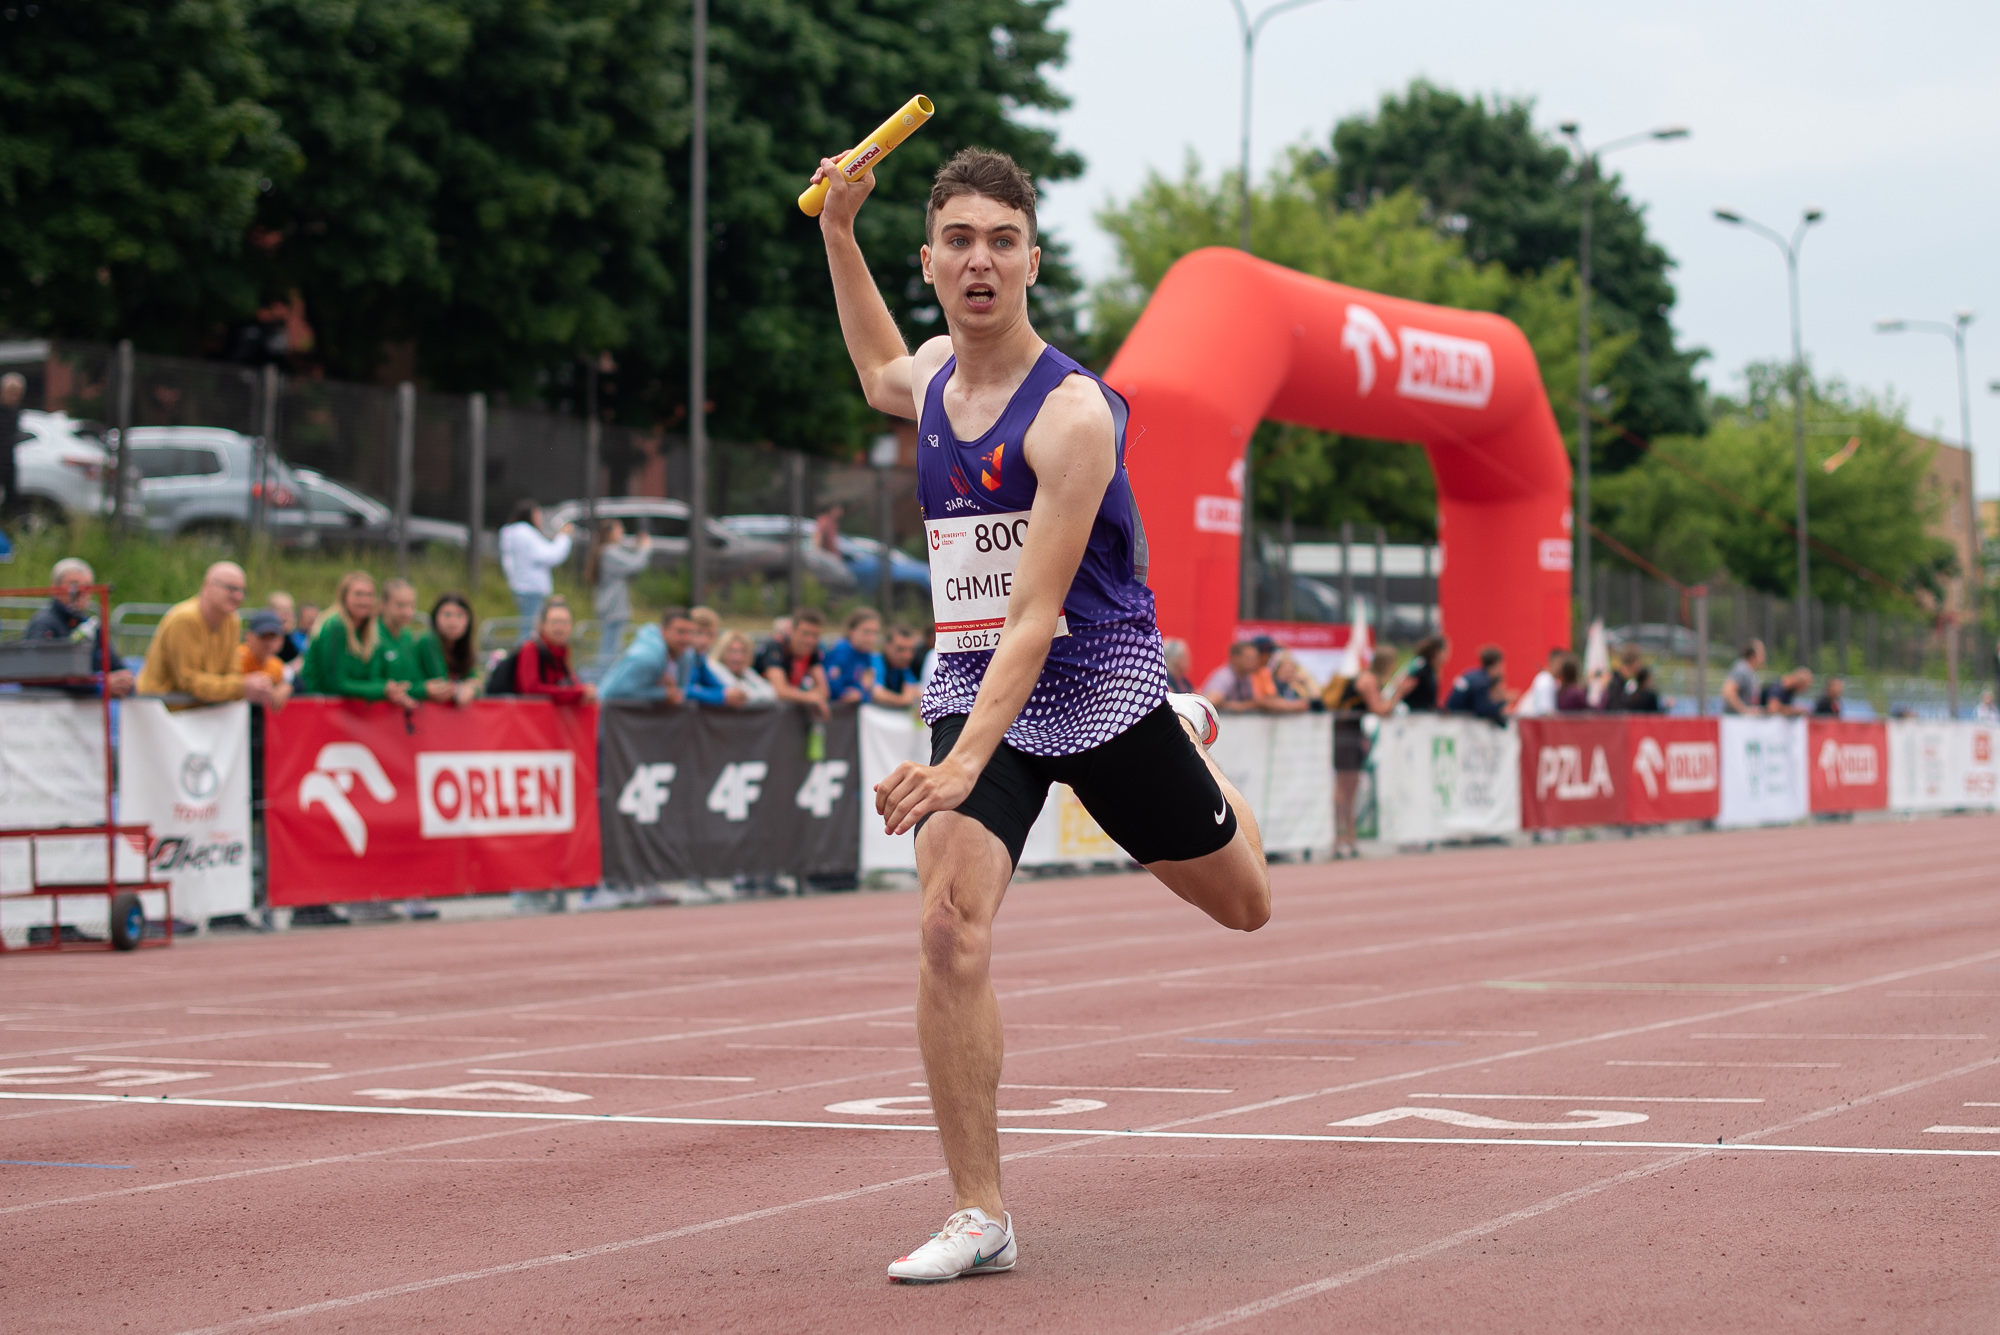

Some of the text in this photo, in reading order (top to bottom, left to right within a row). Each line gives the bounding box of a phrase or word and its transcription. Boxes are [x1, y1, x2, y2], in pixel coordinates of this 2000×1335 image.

[846, 146, 880, 175] POLANIK
[946, 572, 1014, 602] CHMIE
[957, 631, 989, 648] ŁÓDŹ
[432, 765, 563, 823] ORLEN
[617, 763, 677, 824] 4F
[706, 761, 769, 822] 4F
[795, 760, 850, 818] 4F
[1536, 743, 1614, 800] PZLA
